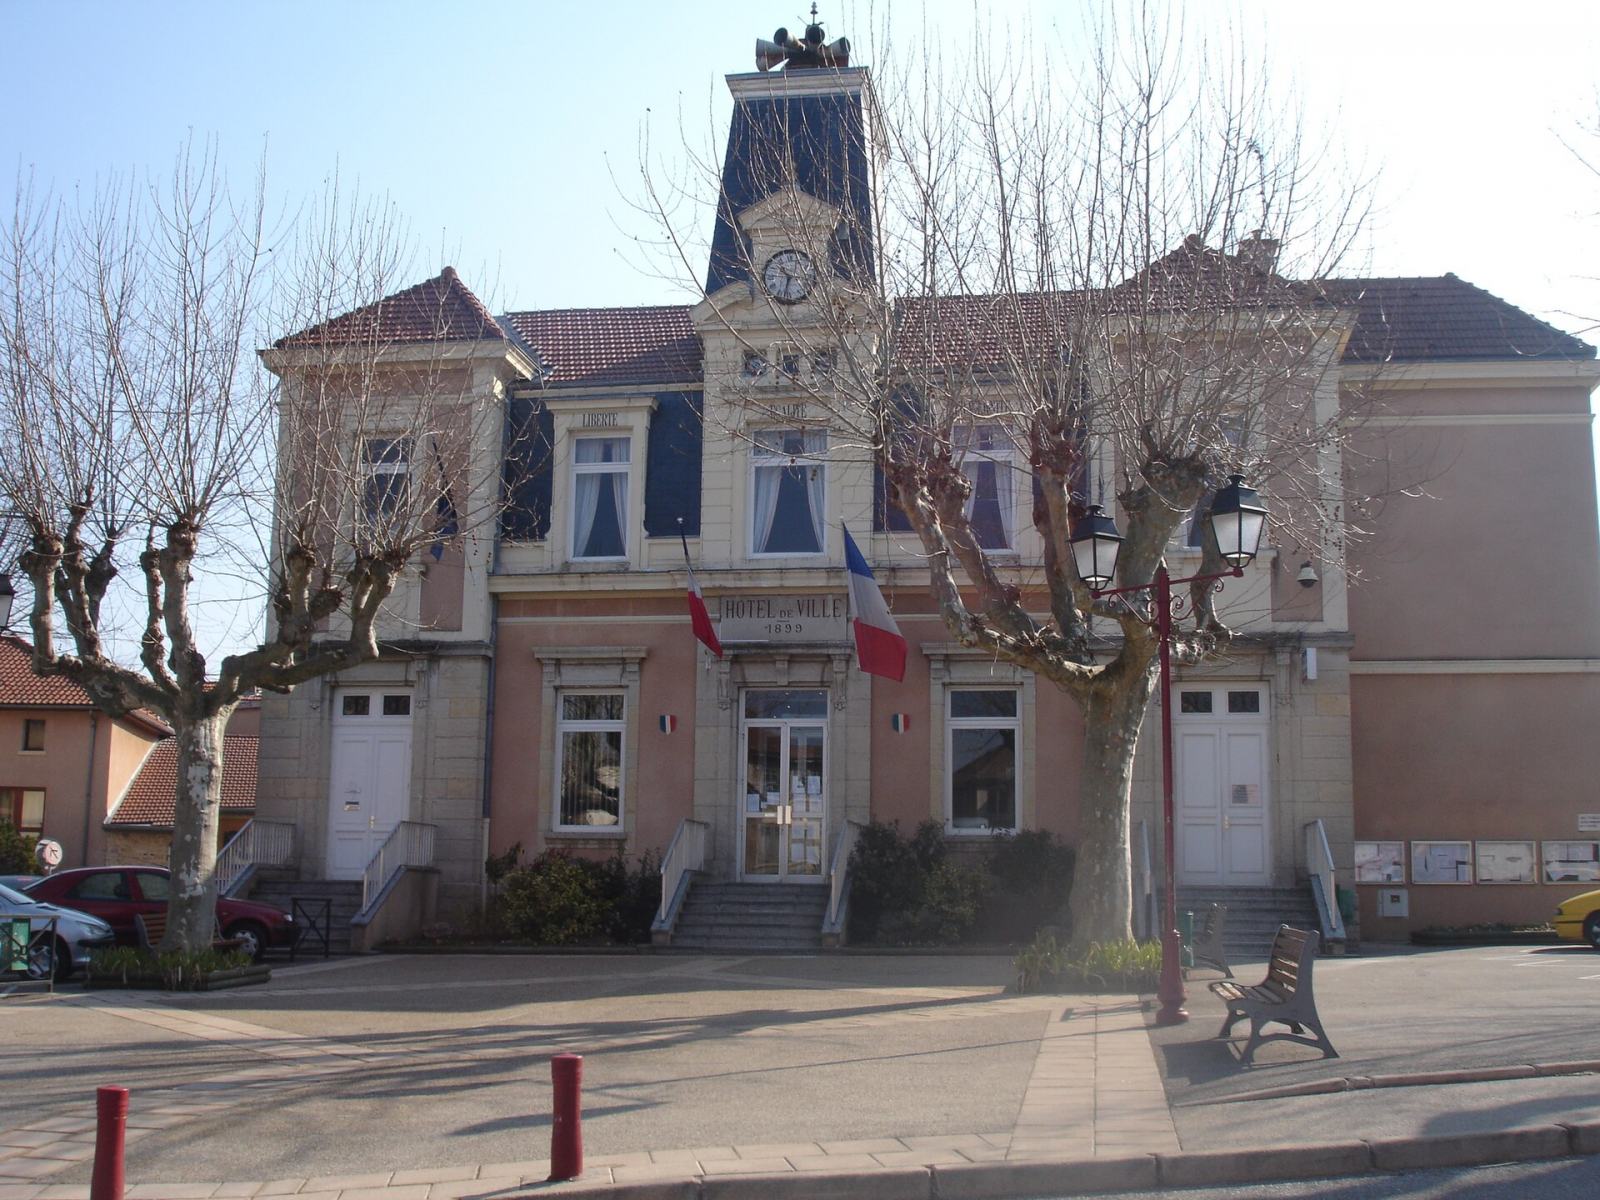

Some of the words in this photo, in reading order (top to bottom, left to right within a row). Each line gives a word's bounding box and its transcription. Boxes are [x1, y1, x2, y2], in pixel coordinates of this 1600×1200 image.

[582, 412, 618, 428] LIBERTE
[726, 599, 776, 619] HOTEL
[779, 609, 794, 618] DE
[796, 599, 842, 618] VILLE
[766, 624, 802, 634] 1899
